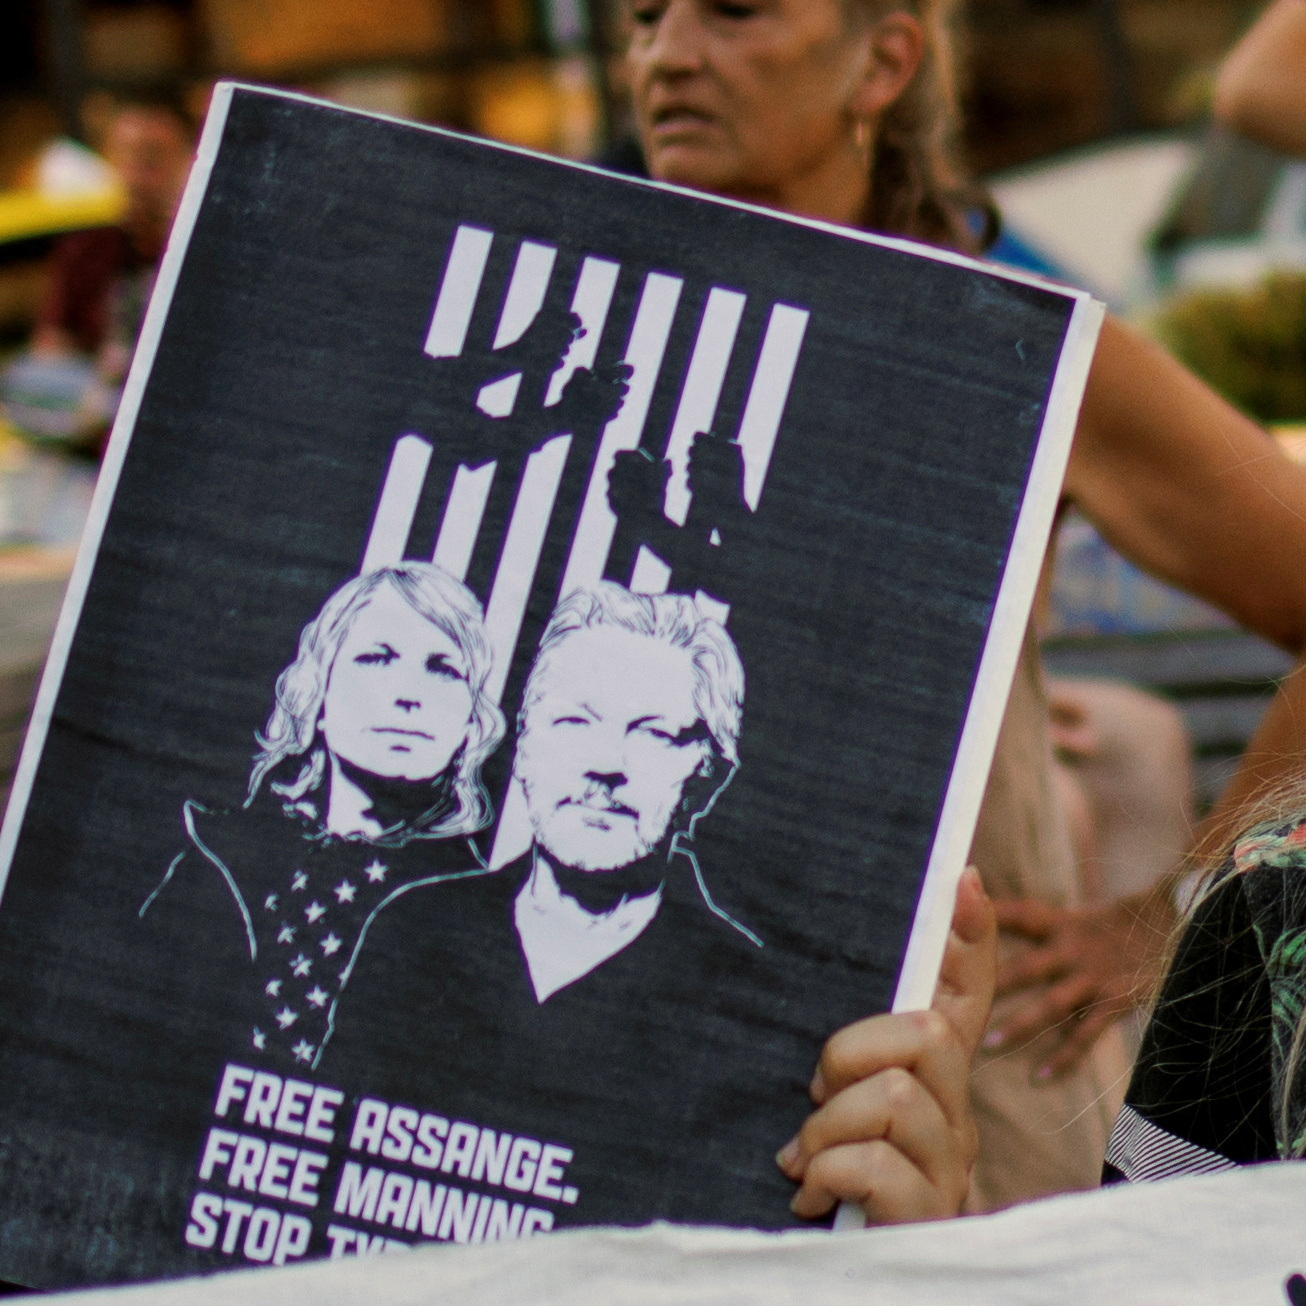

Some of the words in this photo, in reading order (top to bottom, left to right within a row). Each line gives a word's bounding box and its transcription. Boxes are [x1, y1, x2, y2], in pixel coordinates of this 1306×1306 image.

[198, 1127, 329, 1206] FREE
[214, 1062, 345, 1143] FREE
[349, 1098, 580, 1205] ASSANGE.
[184, 1192, 313, 1266] STOP
